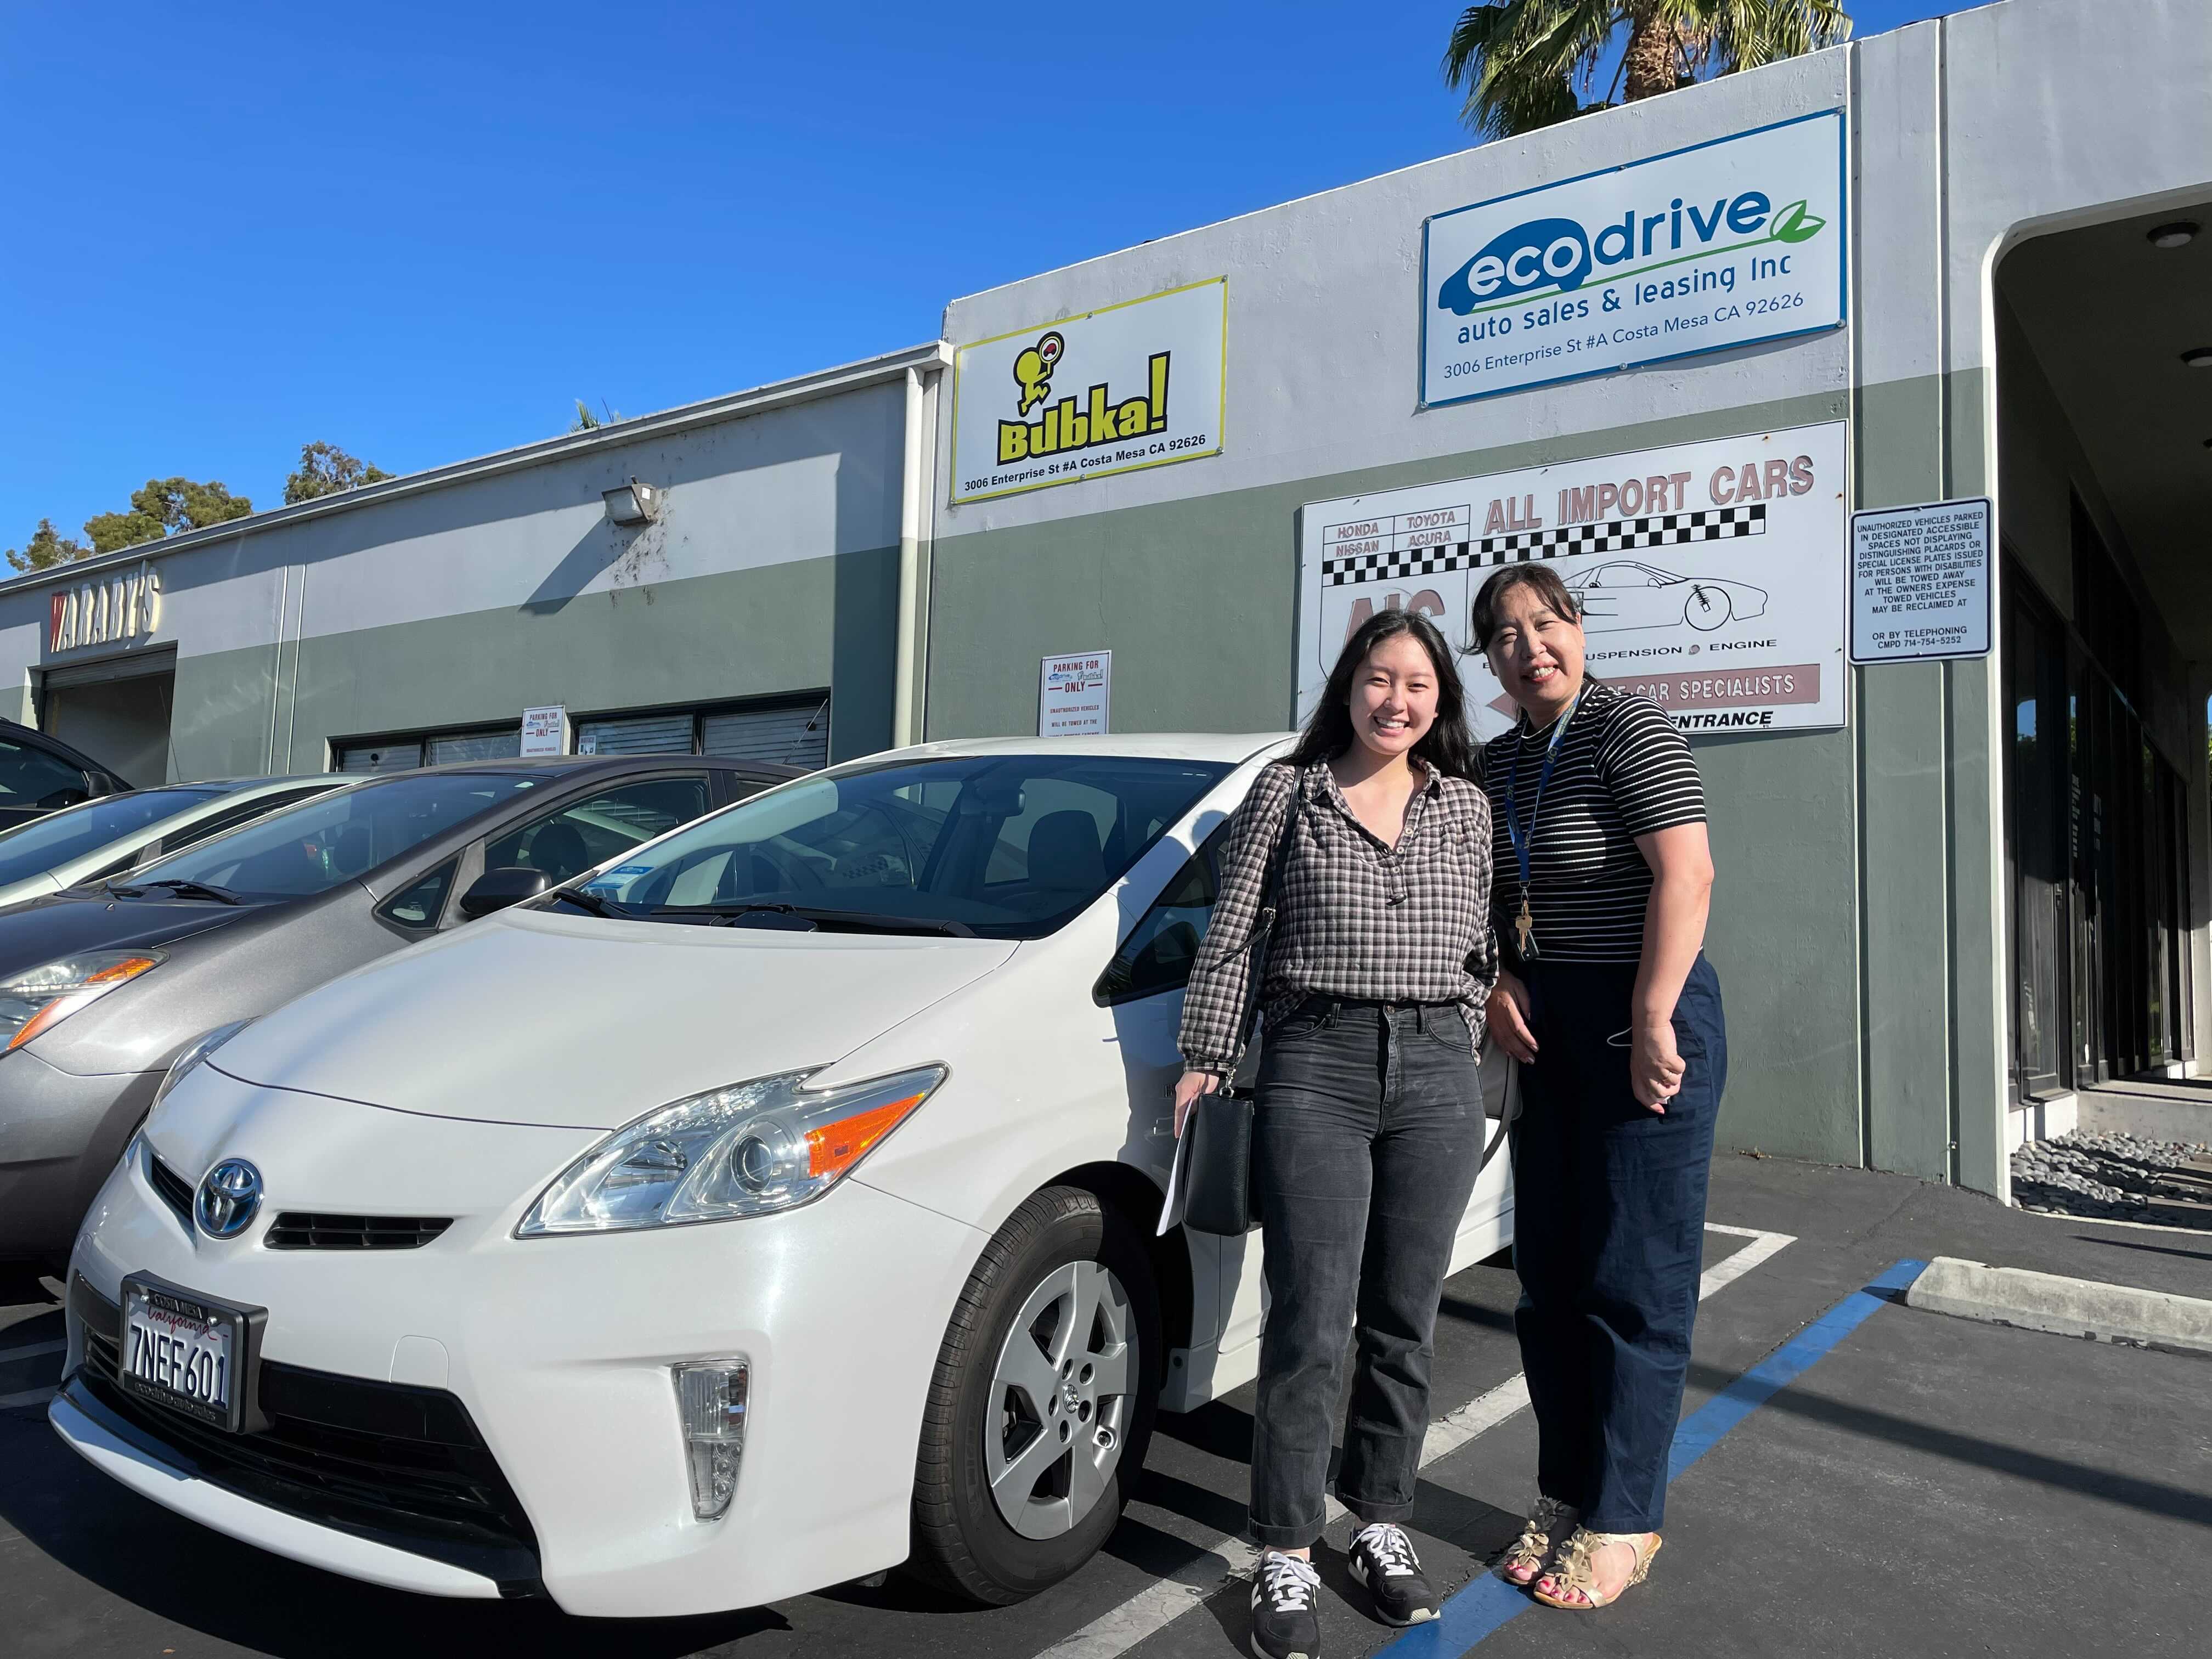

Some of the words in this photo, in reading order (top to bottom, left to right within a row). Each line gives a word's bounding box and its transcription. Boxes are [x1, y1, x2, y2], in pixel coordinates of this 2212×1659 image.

[1468, 191, 1770, 295] ecodrive
[1458, 314, 1512, 345] auto
[1523, 297, 1589, 330] sales
[1603, 289, 1621, 311] &
[1635, 264, 1735, 306] leasing
[1751, 255, 1791, 281] Inc
[1444, 359, 1480, 379] 3006
[1486, 345, 1561, 371] Enterprise
[1566, 338, 1582, 353] St
[1586, 333, 1608, 349] #A
[1613, 324, 1658, 343] Costa
[1664, 314, 1708, 334] Mesa
[1715, 306, 1740, 322] CA
[1746, 292, 1803, 316] 92626
[997, 351, 1171, 465] Bubka!
[965, 478, 988, 491] 3006
[992, 466, 1045, 486] Enterprise
[1048, 464, 1059, 474] St
[1063, 460, 1076, 472] #A
[1080, 453, 1111, 468] Costa
[1116, 448, 1145, 461] Mesa
[1149, 443, 1165, 455] CA
[1170, 434, 1205, 450] 92626
[1483, 494, 1542, 536] ALL
[1558, 471, 1691, 526] IMPORT
[1709, 455, 1814, 505] CARS
[1407, 511, 1455, 529] TOYOTA
[1858, 521, 1911, 532] UNAUTHORIZED
[1915, 516, 1950, 526] VEHICLES
[1954, 512, 1983, 522] PARKED
[1338, 522, 1378, 539] HONDA
[1408, 531, 1452, 547] ACURA
[1872, 528, 1922, 540] DESIGNATED
[1927, 522, 1979, 533] ACCESSIBLE
[1335, 540, 1379, 557] NISSAN
[1869, 541, 1900, 550] SPACES
[1924, 532, 1972, 544] DISPLAYING
[1858, 561, 1887, 569] SPECIAL
[1891, 557, 1921, 566] LICENSE
[1925, 554, 1951, 562] PLATES
[1955, 550, 1983, 559] ISSUED
[1860, 547, 1921, 560] DISTINGUISHING
[1925, 543, 1965, 553] PLACARDS
[1876, 567, 1911, 576] PERSONS
[1936, 560, 1982, 571] DISABILITIES
[1910, 574, 1939, 582] TOWED
[1943, 571, 1965, 579] AWAY
[1897, 584, 1932, 593] OWNERS
[1936, 579, 1975, 589] EXPENSE
[1883, 595, 1911, 603] TOWED
[1916, 590, 1956, 601] VEHICLES
[1906, 601, 1953, 611] RECLAIMED
[1904, 627, 1967, 637] TELEPHONING
[1585, 646, 1681, 660] USPENSION
[1709, 639, 1776, 651] ENGINE
[1904, 636, 1961, 647] 714-754-5252
[1053, 662, 1082, 672] PARKING
[1086, 661, 1098, 669] FOR
[1065, 681, 1085, 692] ONLY
[1637, 682, 1669, 701] CAR
[1679, 674, 1795, 700] SPECIALISTS
[536, 729, 548, 737] ONLY
[131, 1324, 227, 1409] 7NEF601
